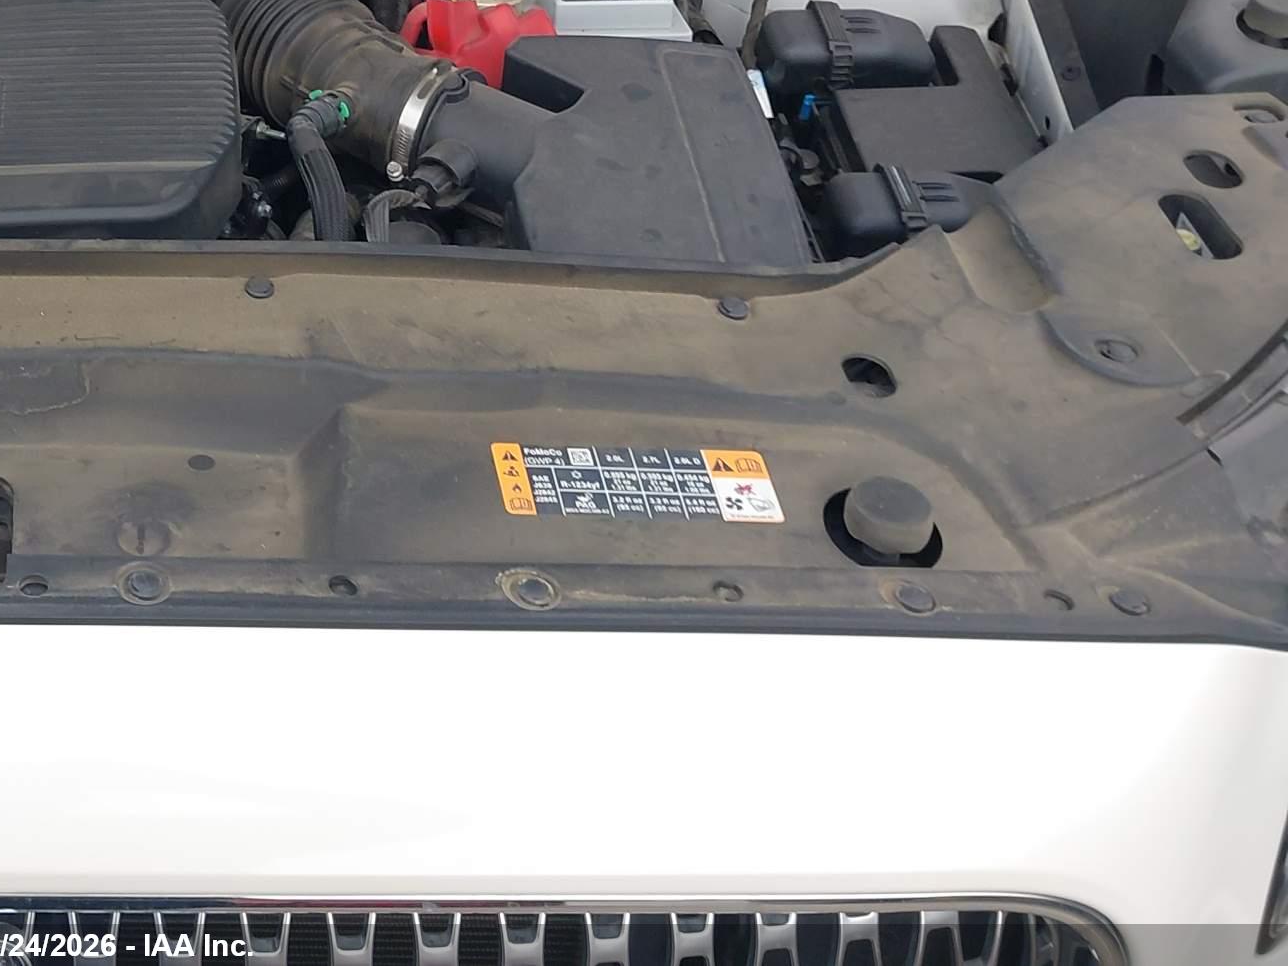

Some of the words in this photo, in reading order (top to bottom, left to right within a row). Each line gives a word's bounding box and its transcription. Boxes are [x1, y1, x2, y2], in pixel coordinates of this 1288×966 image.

[523, 447, 562, 456] FoMoCo
[642, 456, 661, 464] 2.7L
[560, 480, 600, 490] R-1234yf
